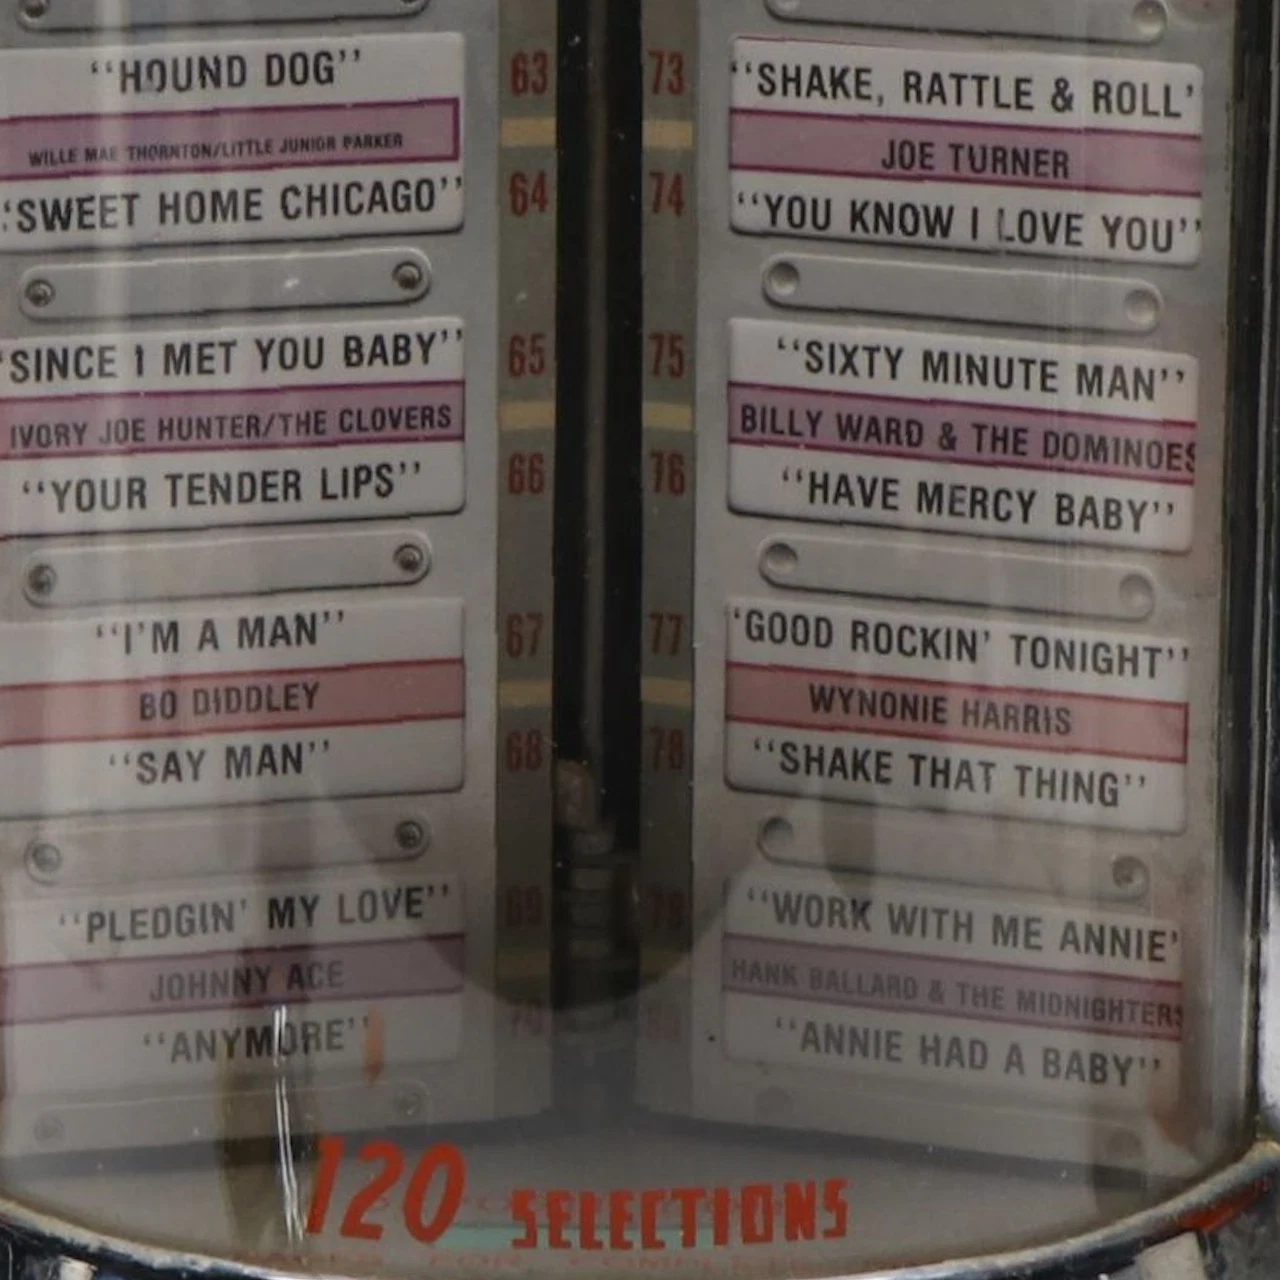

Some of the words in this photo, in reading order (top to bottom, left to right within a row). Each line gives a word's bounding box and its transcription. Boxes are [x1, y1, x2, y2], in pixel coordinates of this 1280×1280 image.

[511, 51, 548, 96] 63
[649, 51, 685, 96] 73
[903, 71, 1033, 111] RATTLE
[1051, 79, 1074, 112] &
[29, 149, 77, 167] WILLE
[85, 146, 118, 163] MAE
[127, 137, 273, 161] THORNTON/LITTLE
[280, 135, 335, 154] JUNIOR
[342, 133, 403, 150] PARKER
[881, 139, 935, 171] JOE
[949, 145, 1069, 180] TURNER
[159, 188, 263, 225] HOME
[510, 171, 548, 216] 64
[649, 172, 685, 216] 74
[850, 201, 954, 239] KNOW
[971, 206, 978, 240] I
[998, 208, 1084, 246] LOVE
[134, 344, 145, 377] I
[163, 340, 238, 377] MET
[255, 336, 324, 371] YOU
[509, 332, 546, 378] 65
[649, 332, 686, 378] 75
[922, 350, 1059, 394] MINUTE
[10, 422, 87, 450] IVORY
[99, 418, 145, 444] JOE
[157, 410, 326, 441] HUNTER/THE
[338, 404, 451, 433] CLOVERS
[740, 404, 822, 438] BILLY
[836, 413, 924, 448] WARD
[939, 422, 956, 451] &
[973, 423, 1029, 455] THE
[165, 469, 301, 509] TENDER
[509, 452, 545, 495] 66
[649, 450, 686, 496] 76
[917, 480, 1036, 522] MERCY
[197, 619, 219, 650] A
[505, 613, 543, 658] 67
[649, 612, 685, 656] 77
[850, 621, 990, 663] ROCKIN'
[140, 692, 176, 720] BO
[193, 682, 320, 716] DIDDLEY
[808, 684, 948, 724] WYNONIE
[962, 700, 1072, 735] HARRIS
[908, 753, 996, 792] THAT
[268, 896, 320, 929] MY
[887, 902, 974, 943] WITH
[992, 914, 1043, 951] ME
[150, 965, 271, 1002] JOHNNY
[287, 961, 344, 990] ACE
[731, 958, 798, 987] HANK
[810, 966, 917, 1001] BALLARD
[928, 980, 944, 1005] &
[957, 981, 1006, 1010] THE
[919, 1034, 990, 1071] HAD
[1004, 1042, 1025, 1074] A
[306, 1137, 466, 1243] 120
[511, 1178, 847, 1250] SELECTIONS
